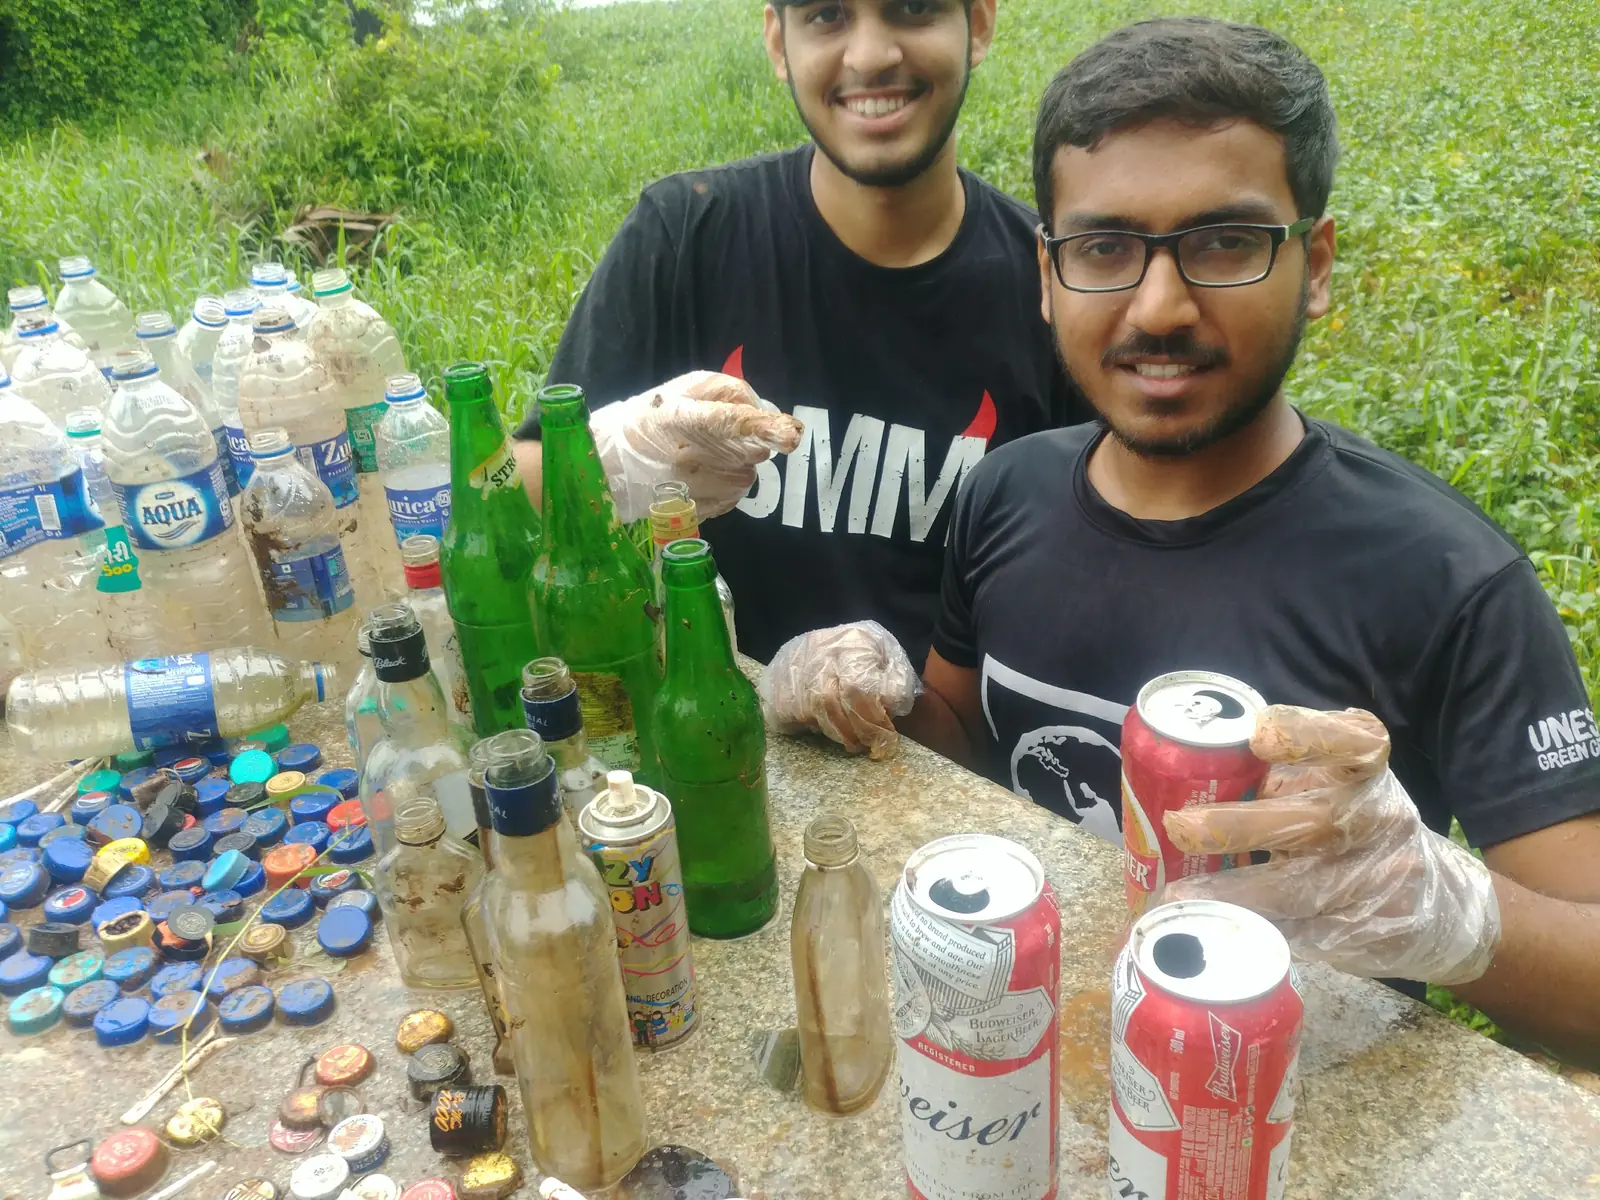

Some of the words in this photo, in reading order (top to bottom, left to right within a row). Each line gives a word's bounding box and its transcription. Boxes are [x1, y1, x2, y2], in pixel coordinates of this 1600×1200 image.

[142, 496, 203, 526] AQUA
[374, 655, 407, 669] Black
[1537, 741, 1589, 771] GREEN
[920, 916, 928, 926] no
[927, 921, 949, 941] brand
[949, 937, 986, 961] produced
[928, 950, 981, 980] smoothness
[931, 940, 947, 954] and
[966, 957, 984, 971] Our
[938, 966, 954, 981] any
[646, 978, 689, 1003] DECORATION
[969, 1007, 1036, 1030] BUDWEISER
[976, 1030, 1016, 1044] LAGER
[918, 1042, 976, 1073] REGISTERED
[1211, 1023, 1232, 1101] Budweiser
